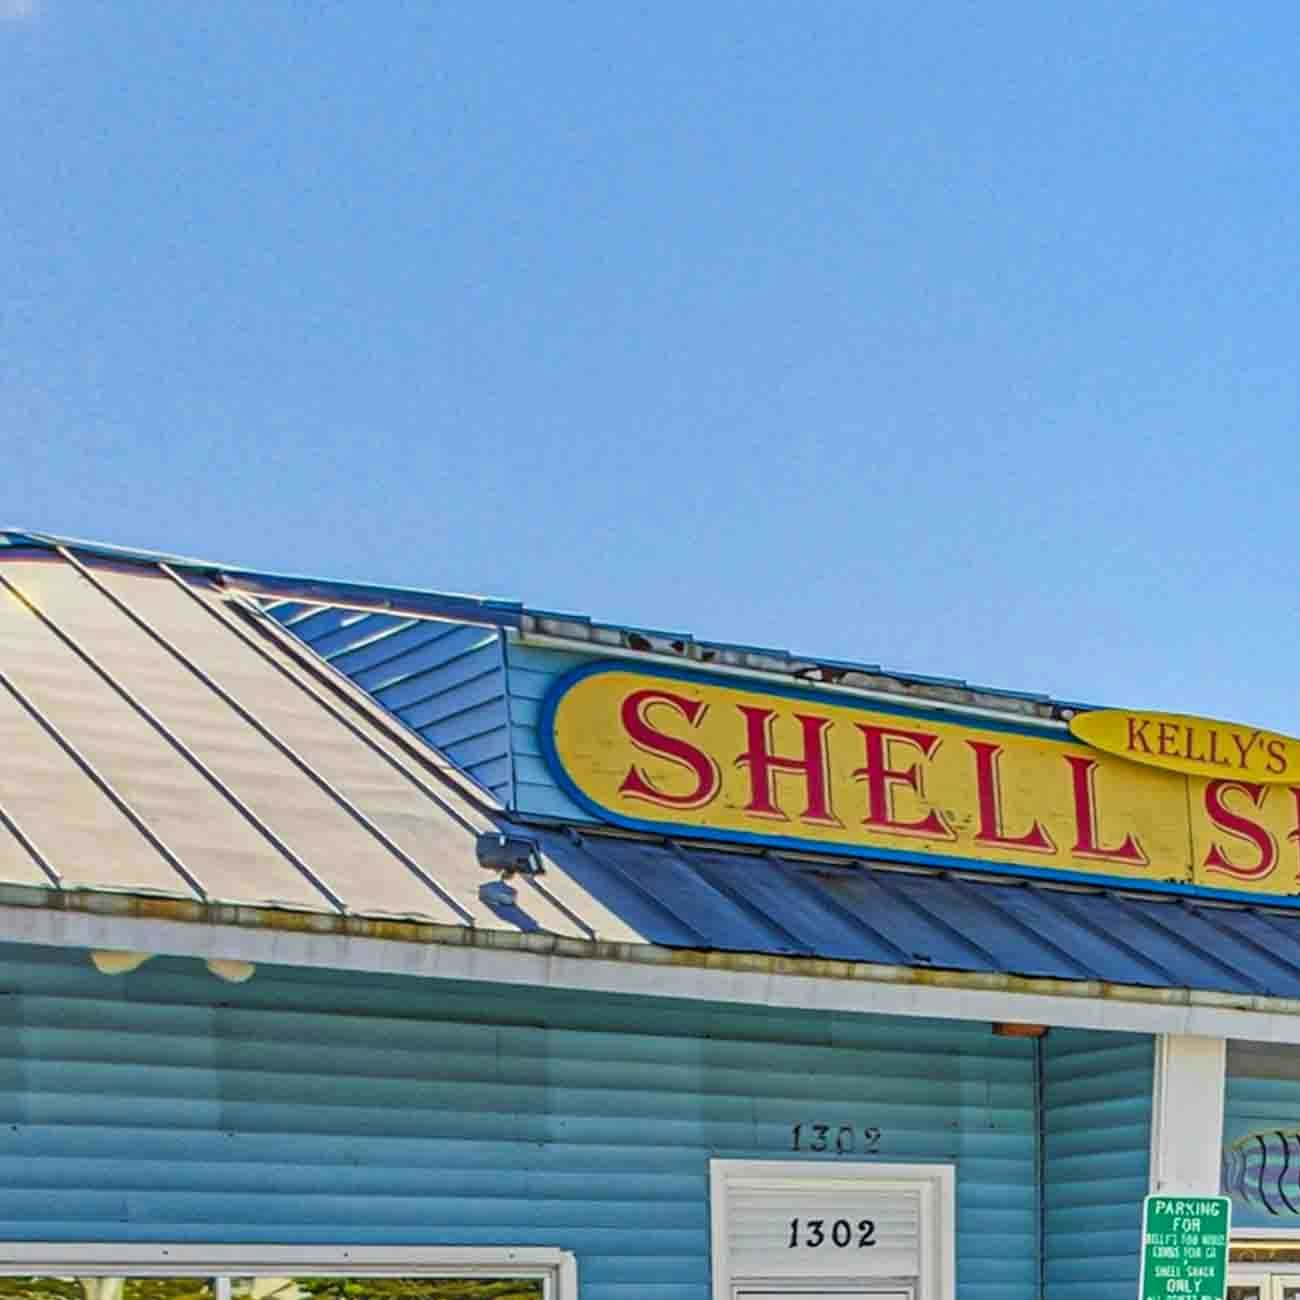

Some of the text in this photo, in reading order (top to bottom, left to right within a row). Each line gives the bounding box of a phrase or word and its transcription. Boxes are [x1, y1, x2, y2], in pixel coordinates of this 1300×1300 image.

[1126, 716, 1289, 776] KELLY'S
[618, 688, 1150, 867] SHELL
[791, 1123, 882, 1155] 1302
[1155, 1199, 1220, 1216] PARKING
[788, 1218, 878, 1249] 1302
[1173, 1216, 1201, 1232] FOR
[1167, 1279, 1203, 1294] ONLY
